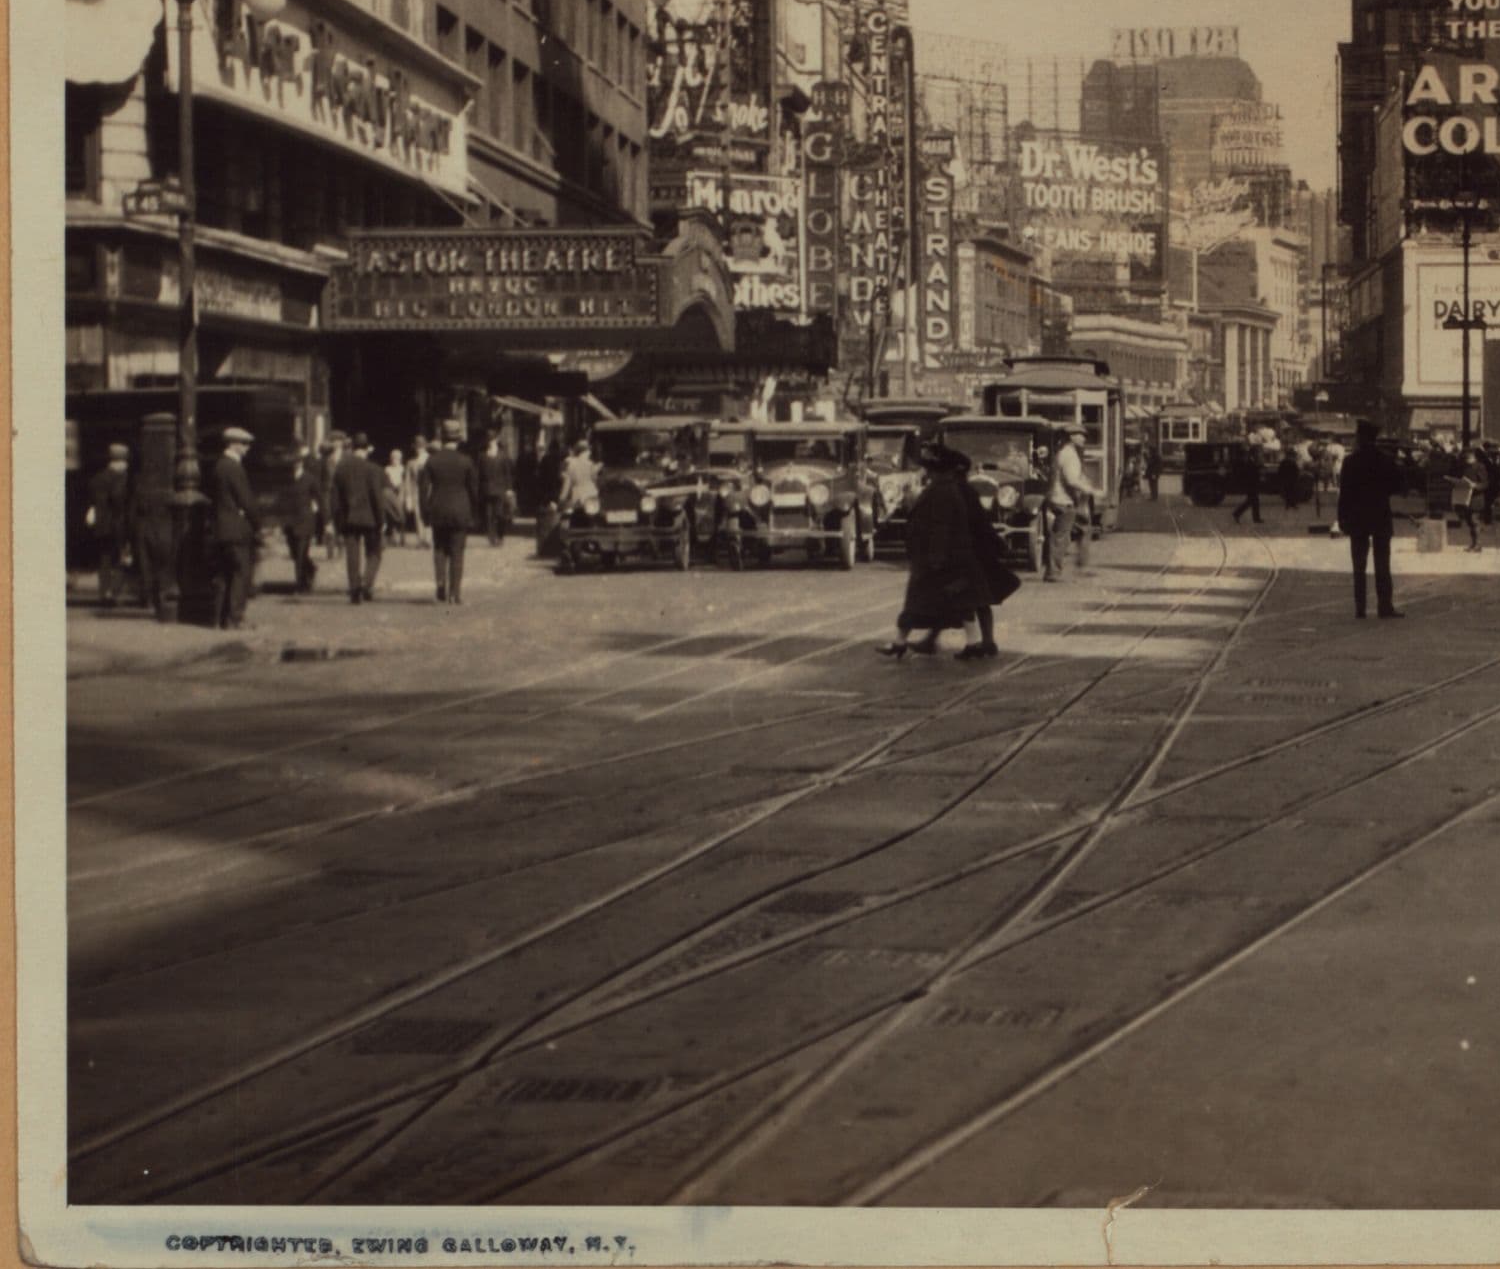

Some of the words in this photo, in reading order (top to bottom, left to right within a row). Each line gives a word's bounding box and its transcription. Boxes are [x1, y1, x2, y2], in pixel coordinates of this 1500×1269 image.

[1020, 140, 1064, 178] Dr.
[1066, 143, 1159, 185] West's
[805, 131, 833, 309] GLOBE
[1022, 182, 1086, 210] TOOTH
[1091, 187, 1156, 214] BRUSH
[367, 248, 469, 273] ASTOR
[486, 247, 622, 273] THEATRE
[848, 175, 873, 333] CANDY
[925, 176, 950, 340] STRAND
[1099, 230, 1157, 256] INSIDE
